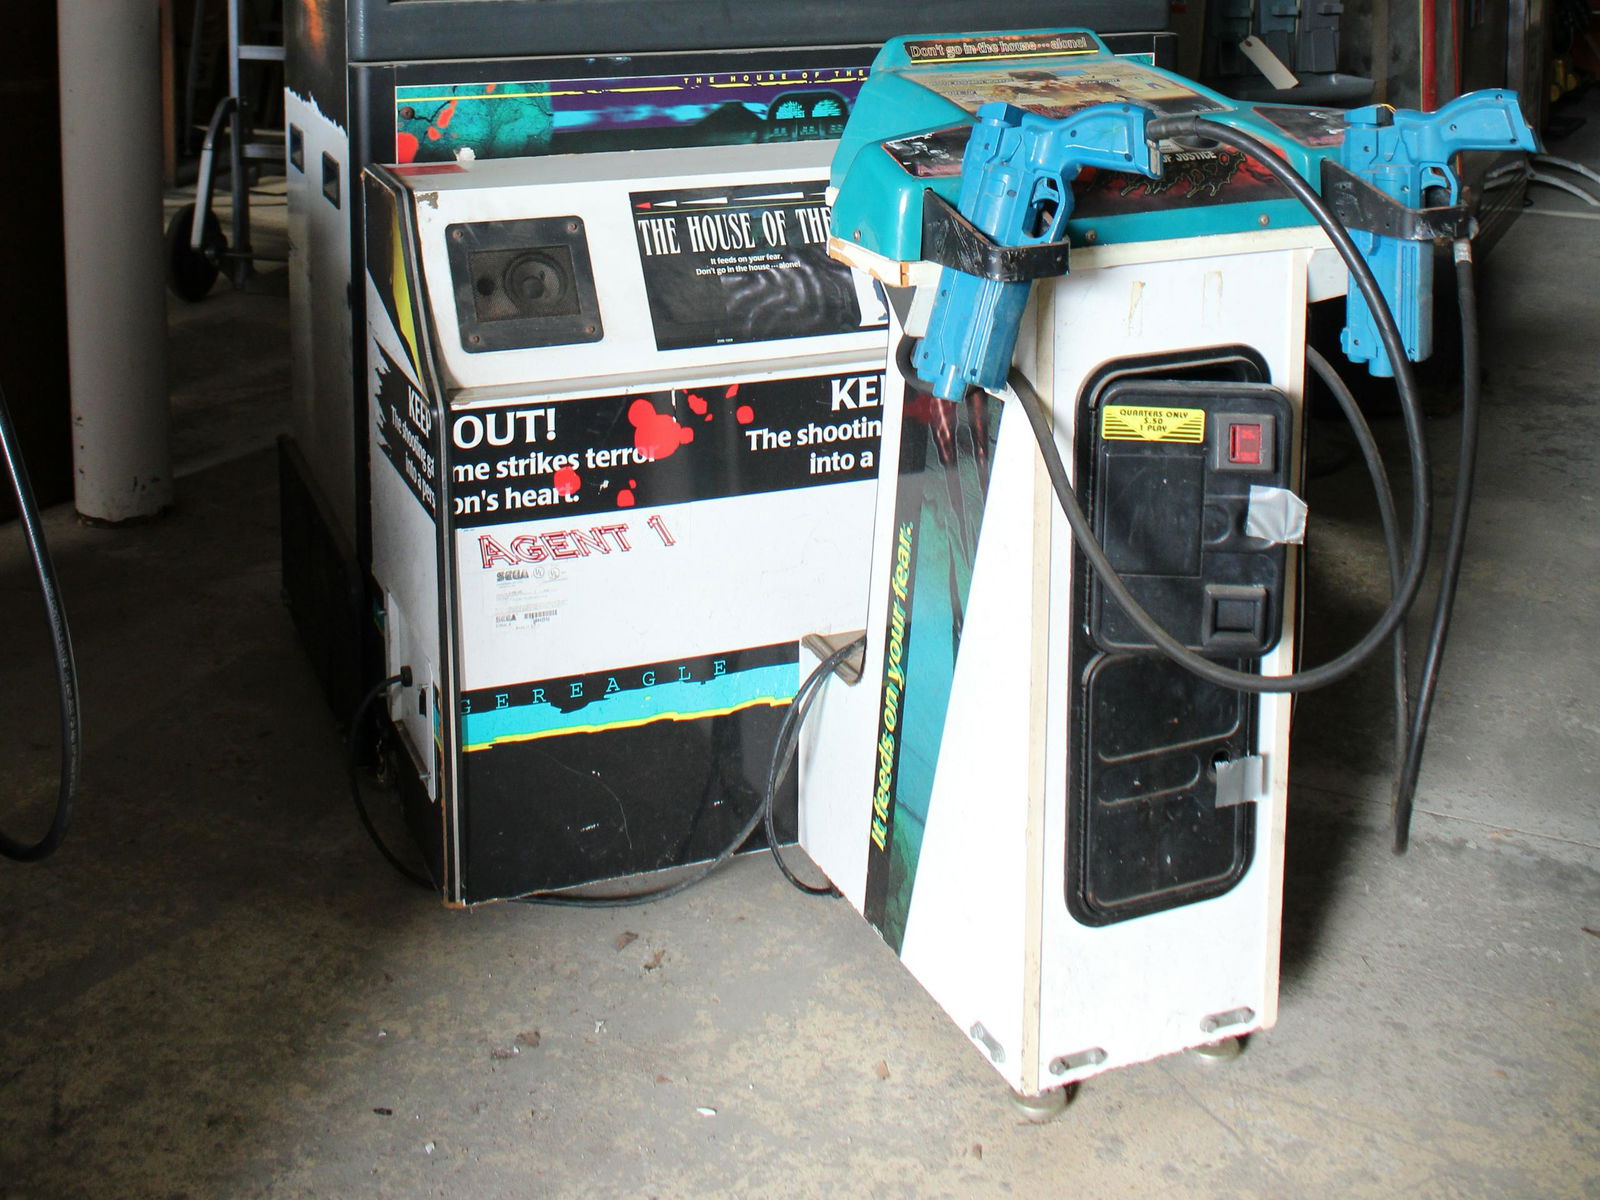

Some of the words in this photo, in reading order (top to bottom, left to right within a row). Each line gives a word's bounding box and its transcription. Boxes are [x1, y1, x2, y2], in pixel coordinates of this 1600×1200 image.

[910, 44, 945, 57] Don't
[946, 45, 963, 58] go
[964, 42, 976, 55] in
[978, 41, 999, 54] the
[999, 40, 1037, 52] house
[684, 75, 715, 84] THE
[730, 73, 787, 83] HOUSE
[802, 71, 820, 79] OF
[834, 69, 864, 78] THE
[1175, 151, 1217, 161] JUSTICE
[638, 217, 680, 256] THE
[686, 210, 756, 253] HOUSE
[761, 209, 788, 247] OF
[795, 206, 832, 245] THE
[696, 267, 716, 276] Don't
[717, 267, 726, 275] go
[727, 265, 735, 273] in
[717, 256, 737, 265] feeds
[749, 255, 766, 264] your
[766, 253, 783, 261] fear.
[408, 385, 432, 439] KEEP
[831, 375, 886, 412] KE
[453, 407, 556, 449] OUT!
[1119, 409, 1163, 418] QUARTERS
[391, 404, 402, 435] The
[402, 420, 427, 473] shooting
[745, 428, 792, 451] The
[797, 416, 882, 446] shootin
[405, 450, 417, 484] into
[417, 472, 422, 491] a
[422, 479, 436, 509] pers
[496, 452, 579, 479] strikes
[586, 446, 660, 469] terror
[810, 451, 855, 474] into
[860, 450, 873, 469] a
[505, 482, 580, 510] heart.
[478, 522, 632, 568] AGENT
[647, 514, 676, 546] 1
[892, 521, 913, 601] fear.
[888, 599, 906, 690] your
[883, 682, 899, 733] on
[874, 730, 895, 823] feeds
[871, 815, 887, 852] It
